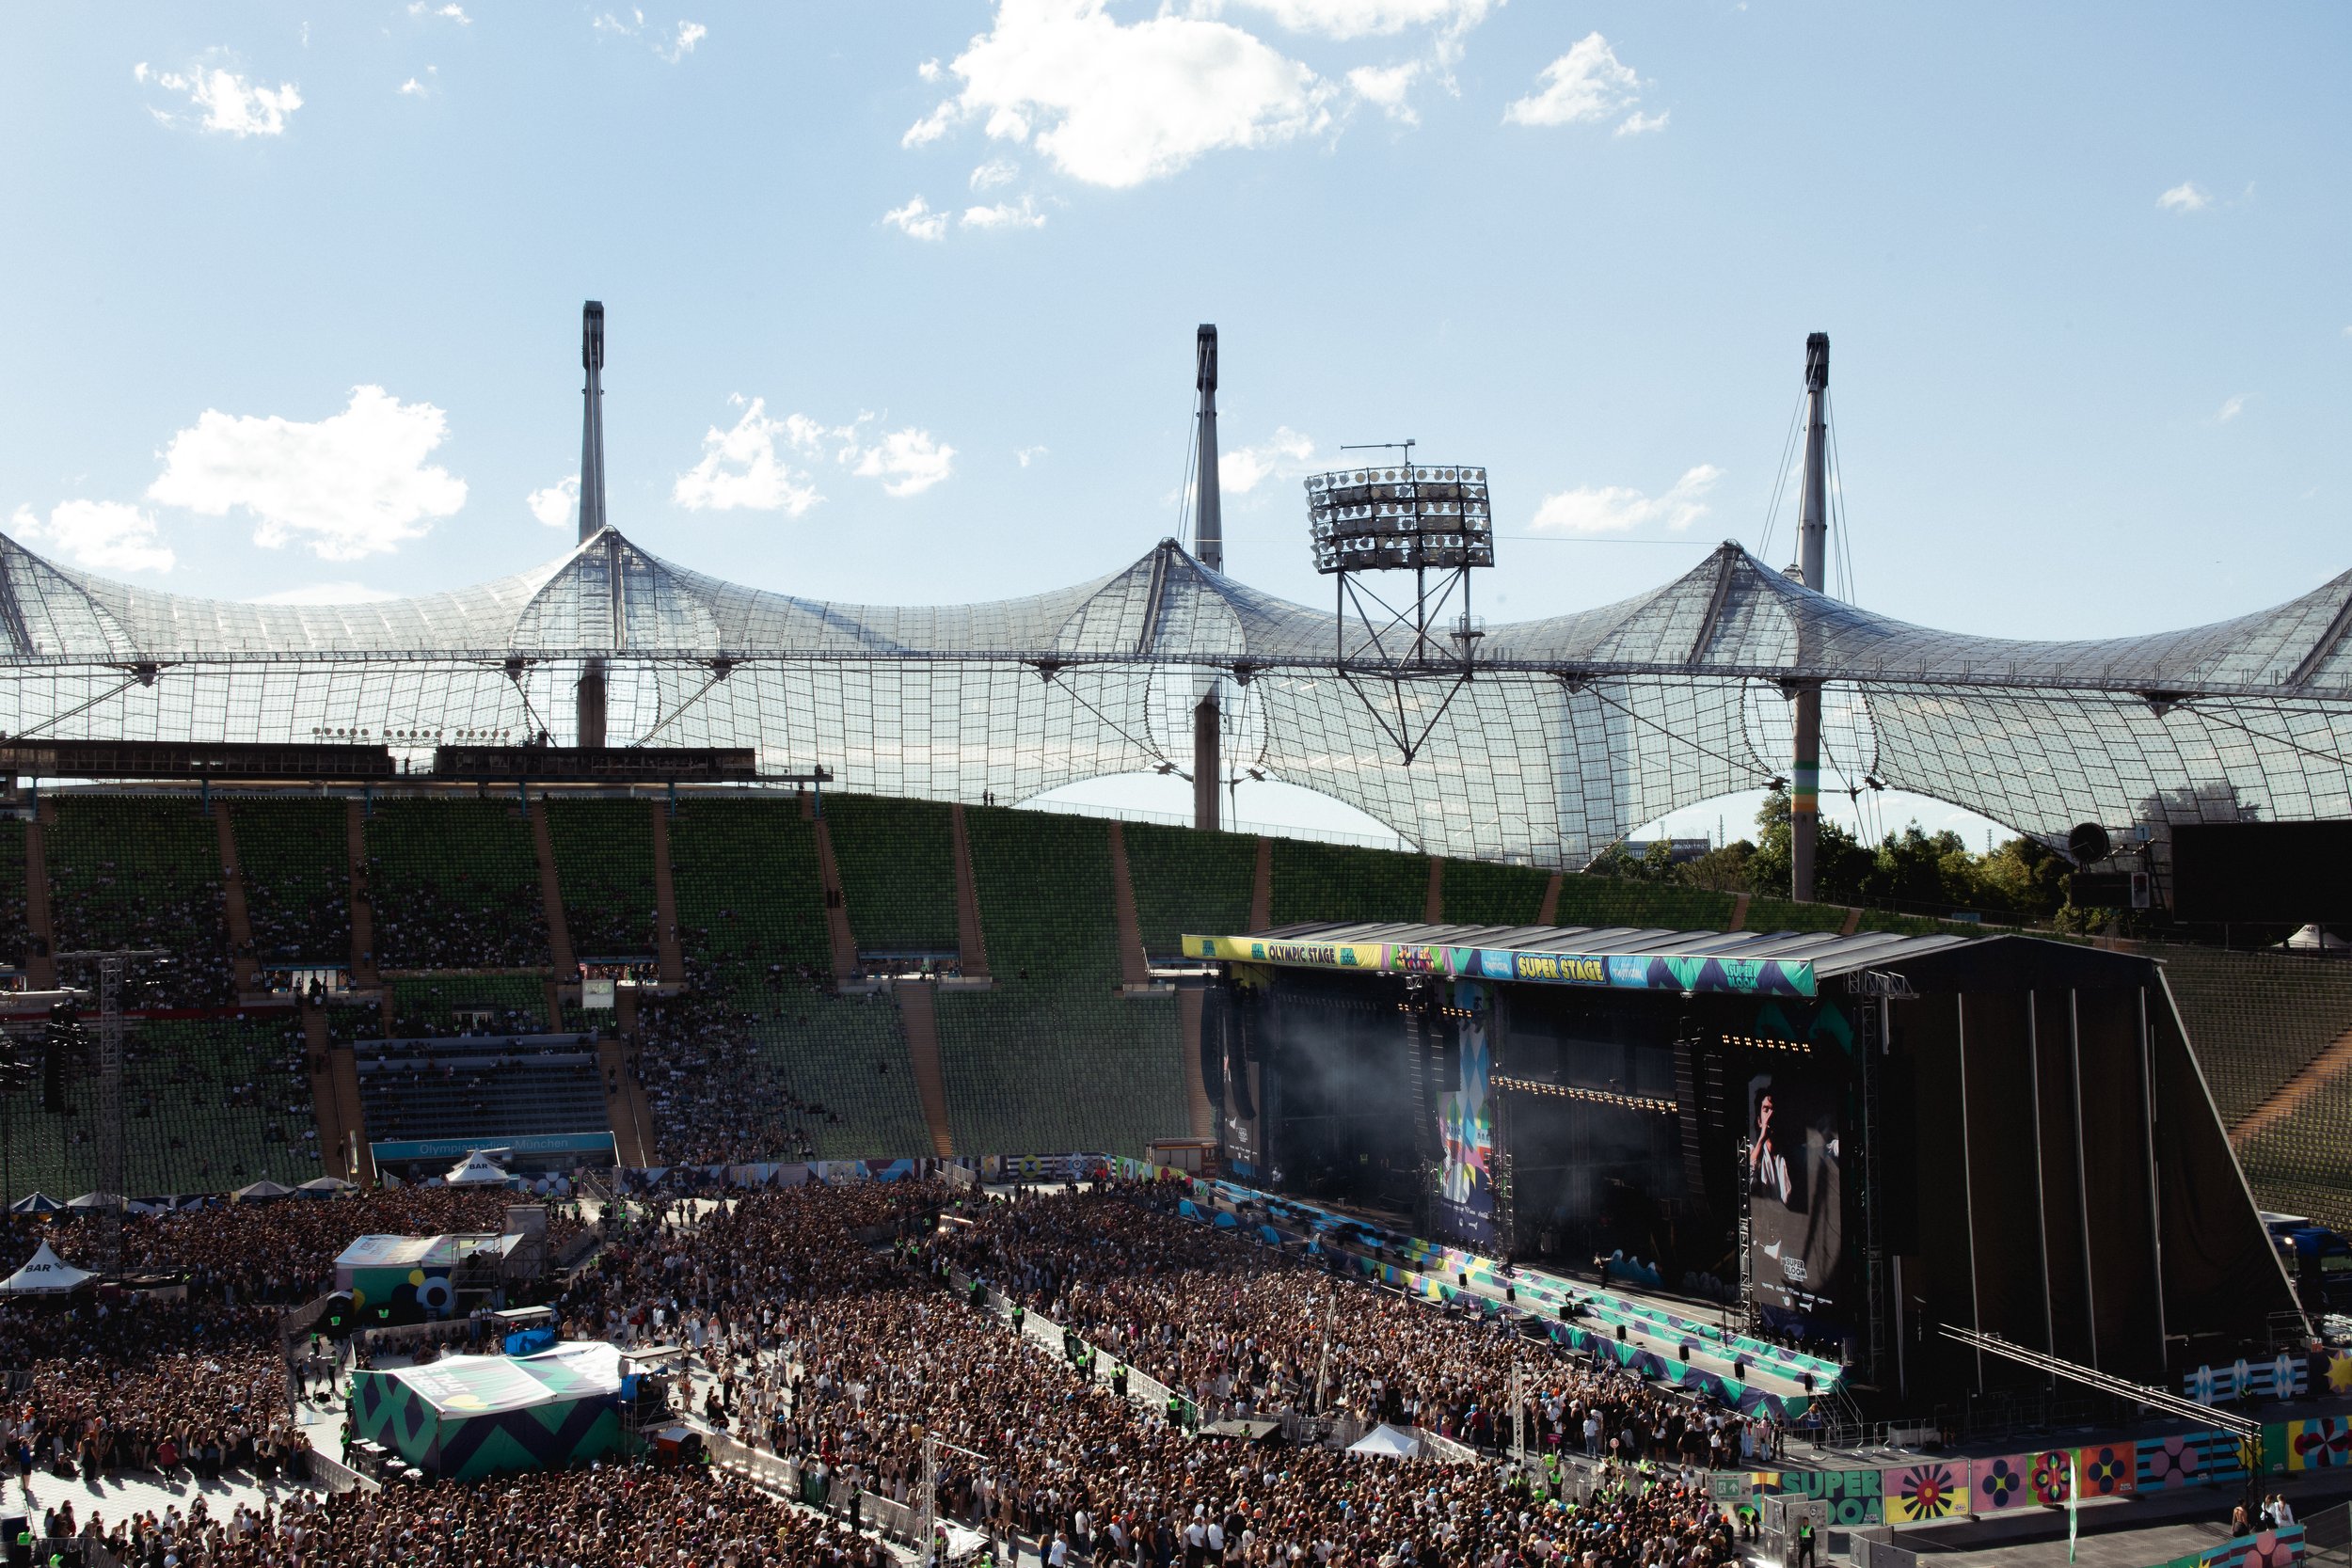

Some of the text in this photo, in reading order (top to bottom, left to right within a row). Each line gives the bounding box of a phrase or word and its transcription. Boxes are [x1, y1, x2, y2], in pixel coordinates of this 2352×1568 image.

[2139, 827, 2145, 839] 1
[1268, 944, 1307, 962] OLYMPIC
[1308, 946, 1335, 964] STAGE
[1518, 955, 1560, 979] SUPER
[1560, 958, 1604, 981] STAGE
[1727, 964, 1755, 977] SUPER
[1726, 976, 1758, 990] BLOOM
[515, 1138, 568, 1149] München
[24, 1263, 51, 1274] BAR
[1786, 1257, 1804, 1269] SUPER
[1785, 1265, 1807, 1277] BLOOM
[1782, 1470, 1882, 1498] SUPER
